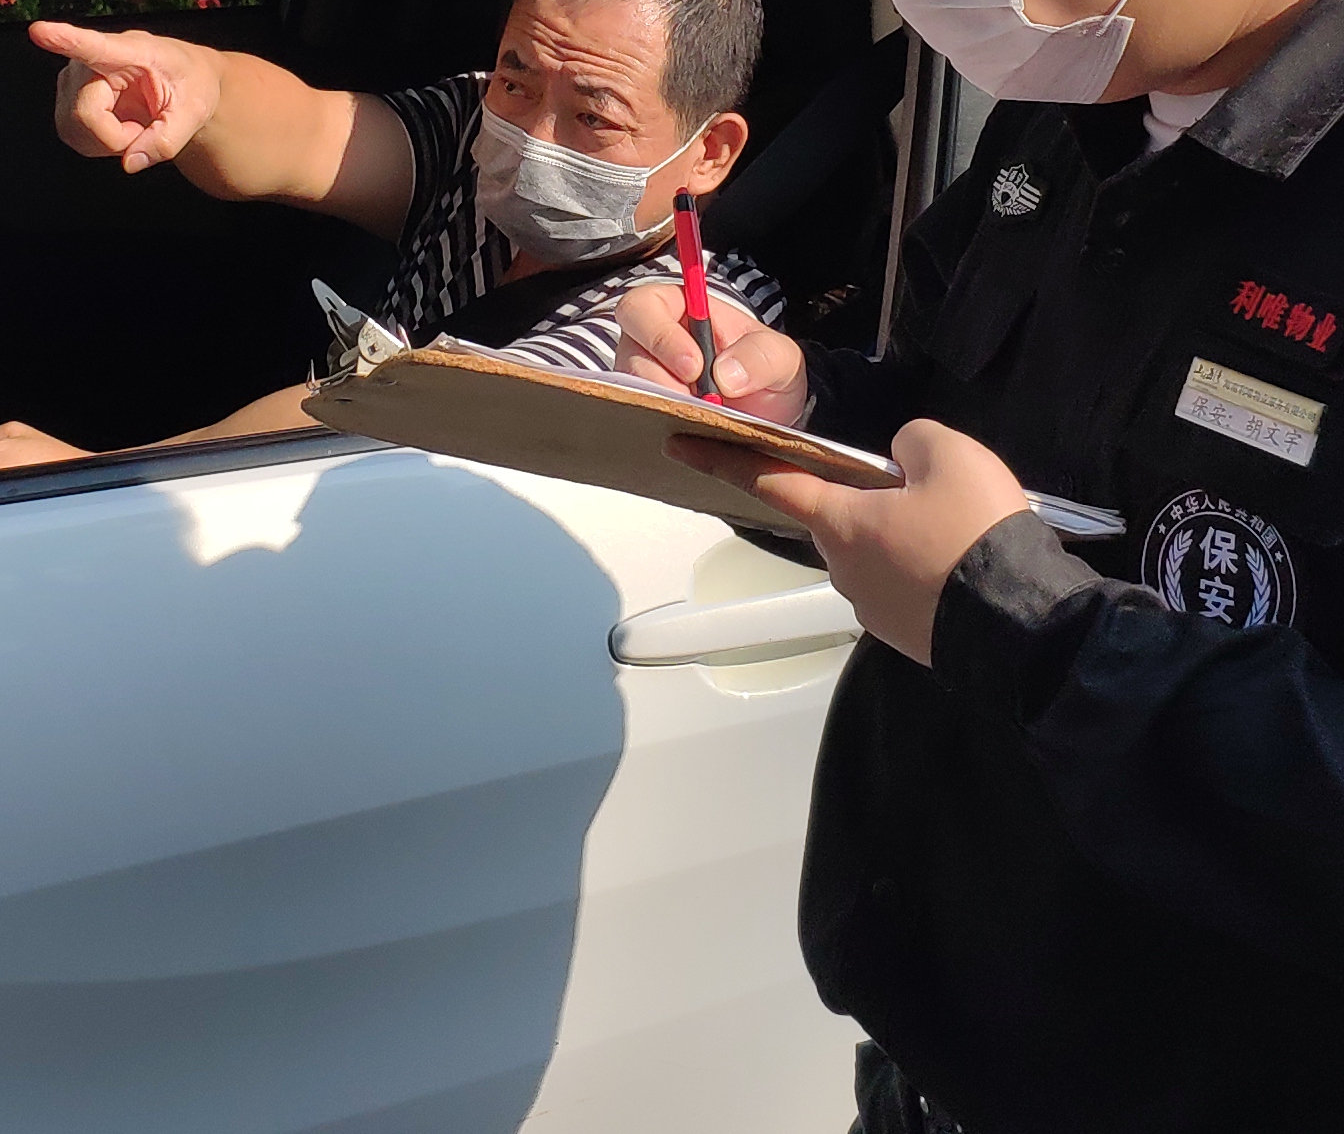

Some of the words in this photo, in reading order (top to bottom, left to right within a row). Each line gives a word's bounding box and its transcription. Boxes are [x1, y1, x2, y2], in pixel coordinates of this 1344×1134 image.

[1229, 280, 1338, 353] 利唯物业
[1198, 525, 1240, 625] 保安
